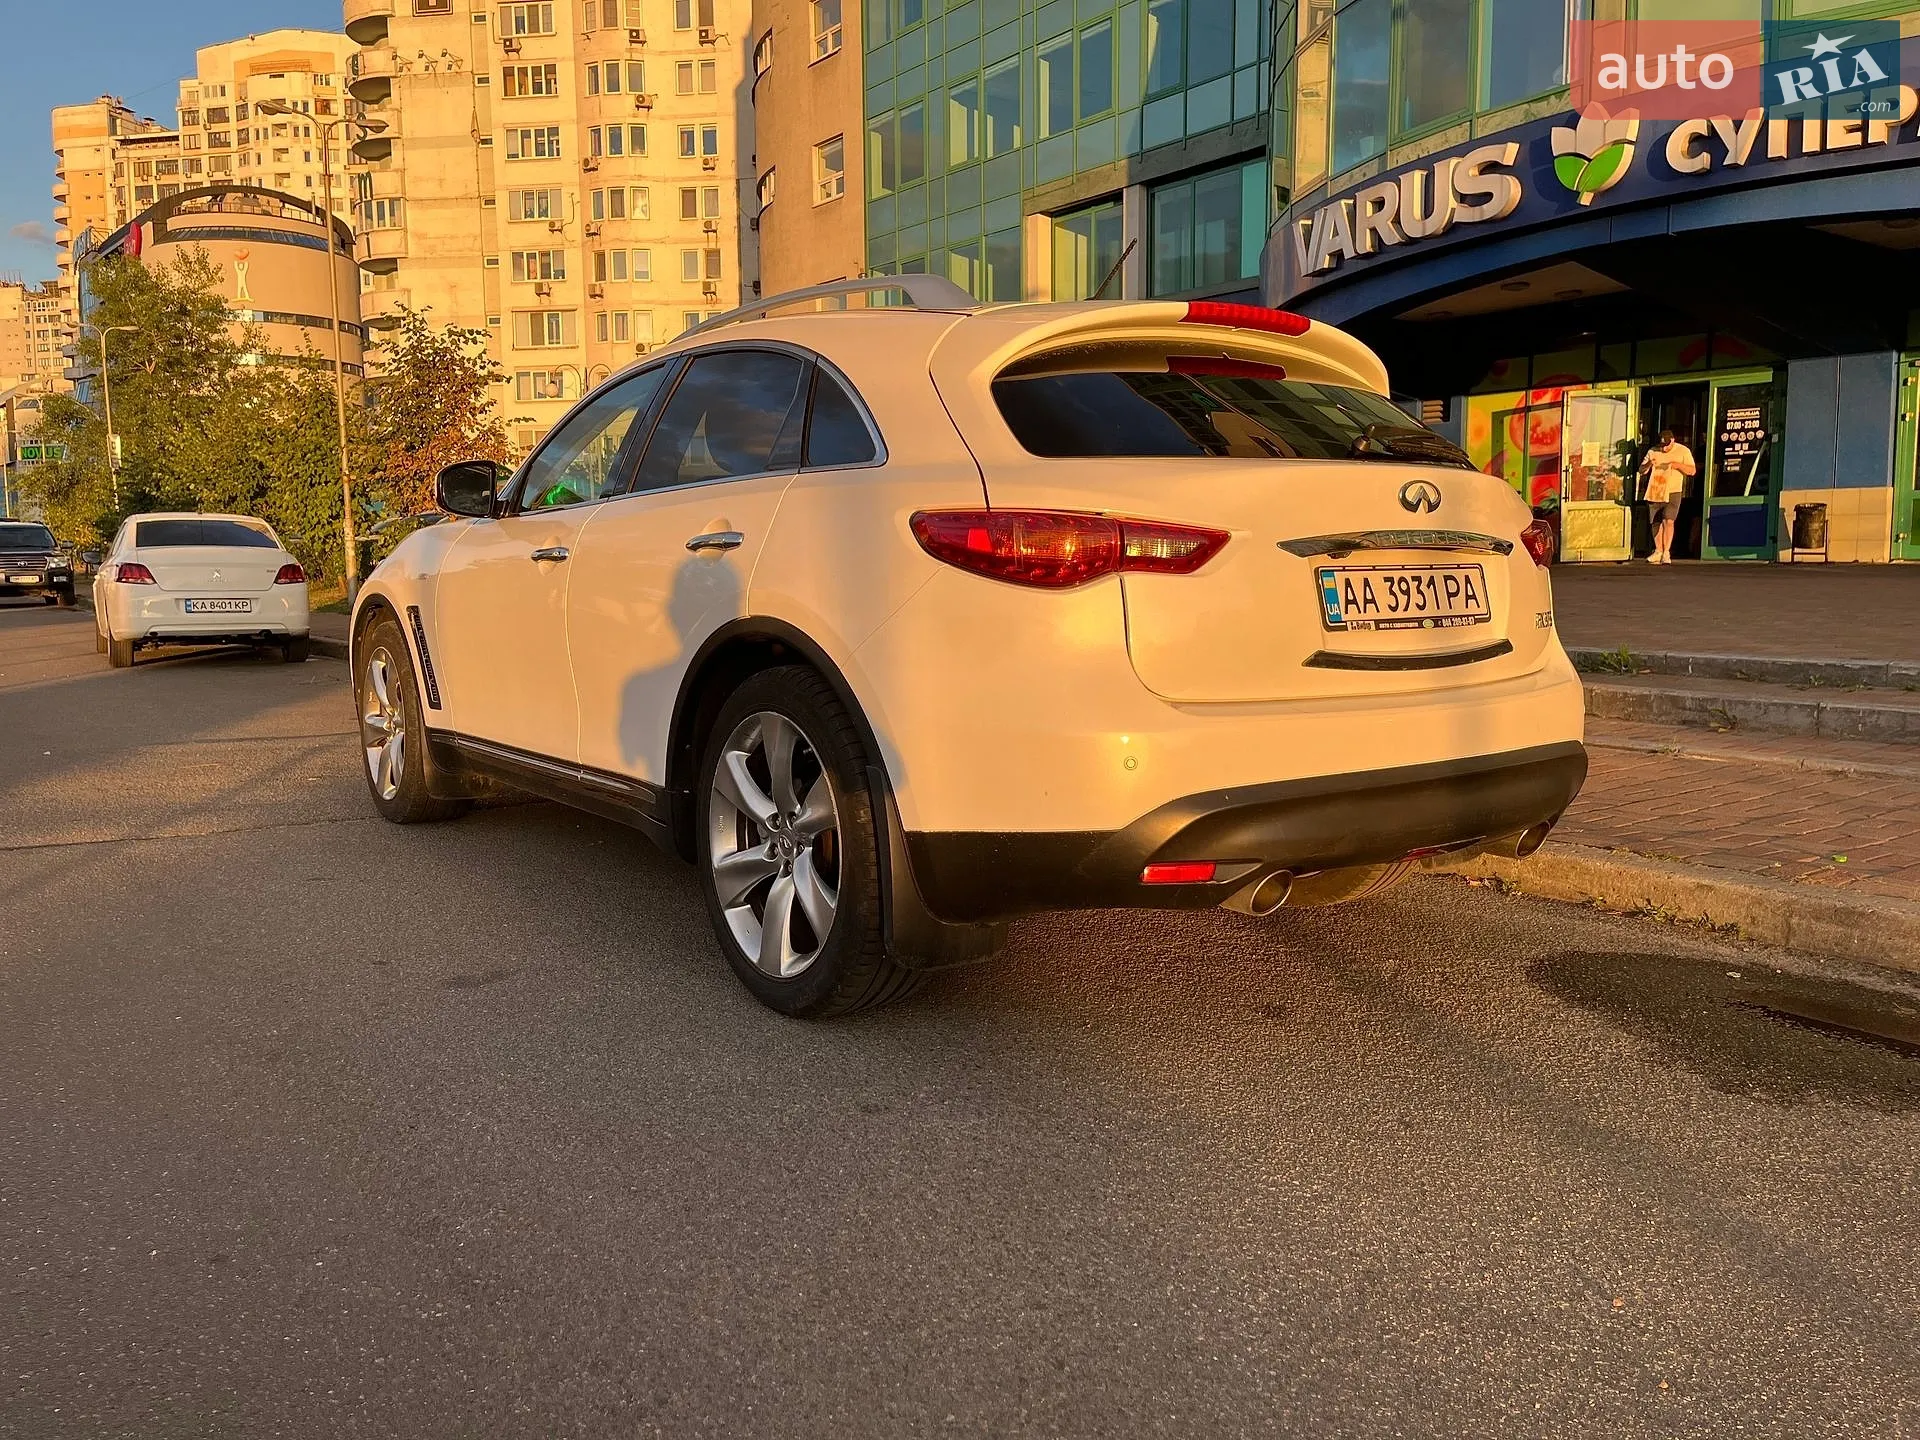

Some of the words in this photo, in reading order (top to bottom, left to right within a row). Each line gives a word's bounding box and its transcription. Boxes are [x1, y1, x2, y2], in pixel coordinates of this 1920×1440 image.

[1665, 84, 1920, 175] СУПЕР
[1291, 141, 1523, 277] VARUS
[192, 601, 208, 611] KA
[209, 601, 233, 611] 8401
[234, 601, 249, 610] KP
[1327, 603, 1340, 616] UA
[1344, 577, 1380, 615] AA
[1383, 575, 1440, 613] 3931
[1443, 574, 1481, 610] PA
